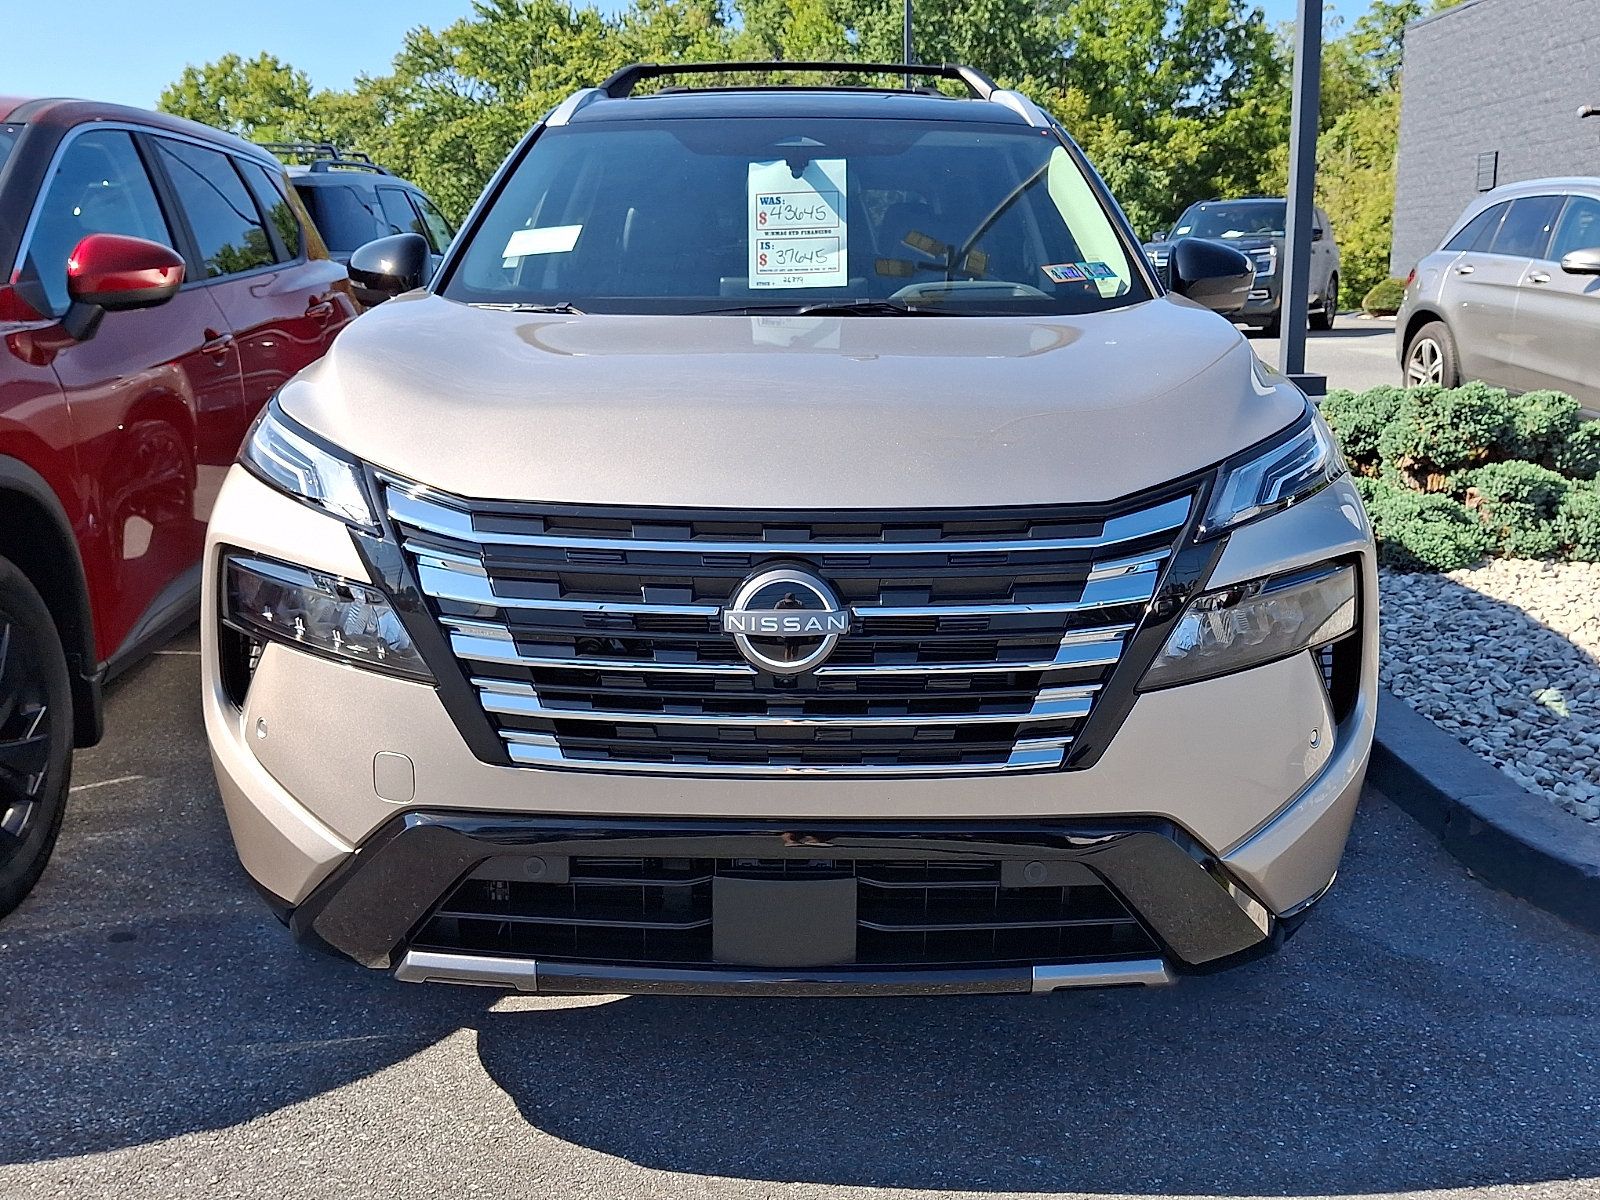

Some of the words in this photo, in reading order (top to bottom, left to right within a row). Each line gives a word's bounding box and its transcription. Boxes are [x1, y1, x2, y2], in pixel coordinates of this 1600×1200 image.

[759, 197, 785, 205] WAS:
[759, 211, 767, 225] $
[770, 205, 826, 220] 43645
[760, 242, 775, 250] IS:
[759, 253, 767, 266] $
[776, 249, 827, 264] 37645
[728, 615, 845, 632] NISSAN
